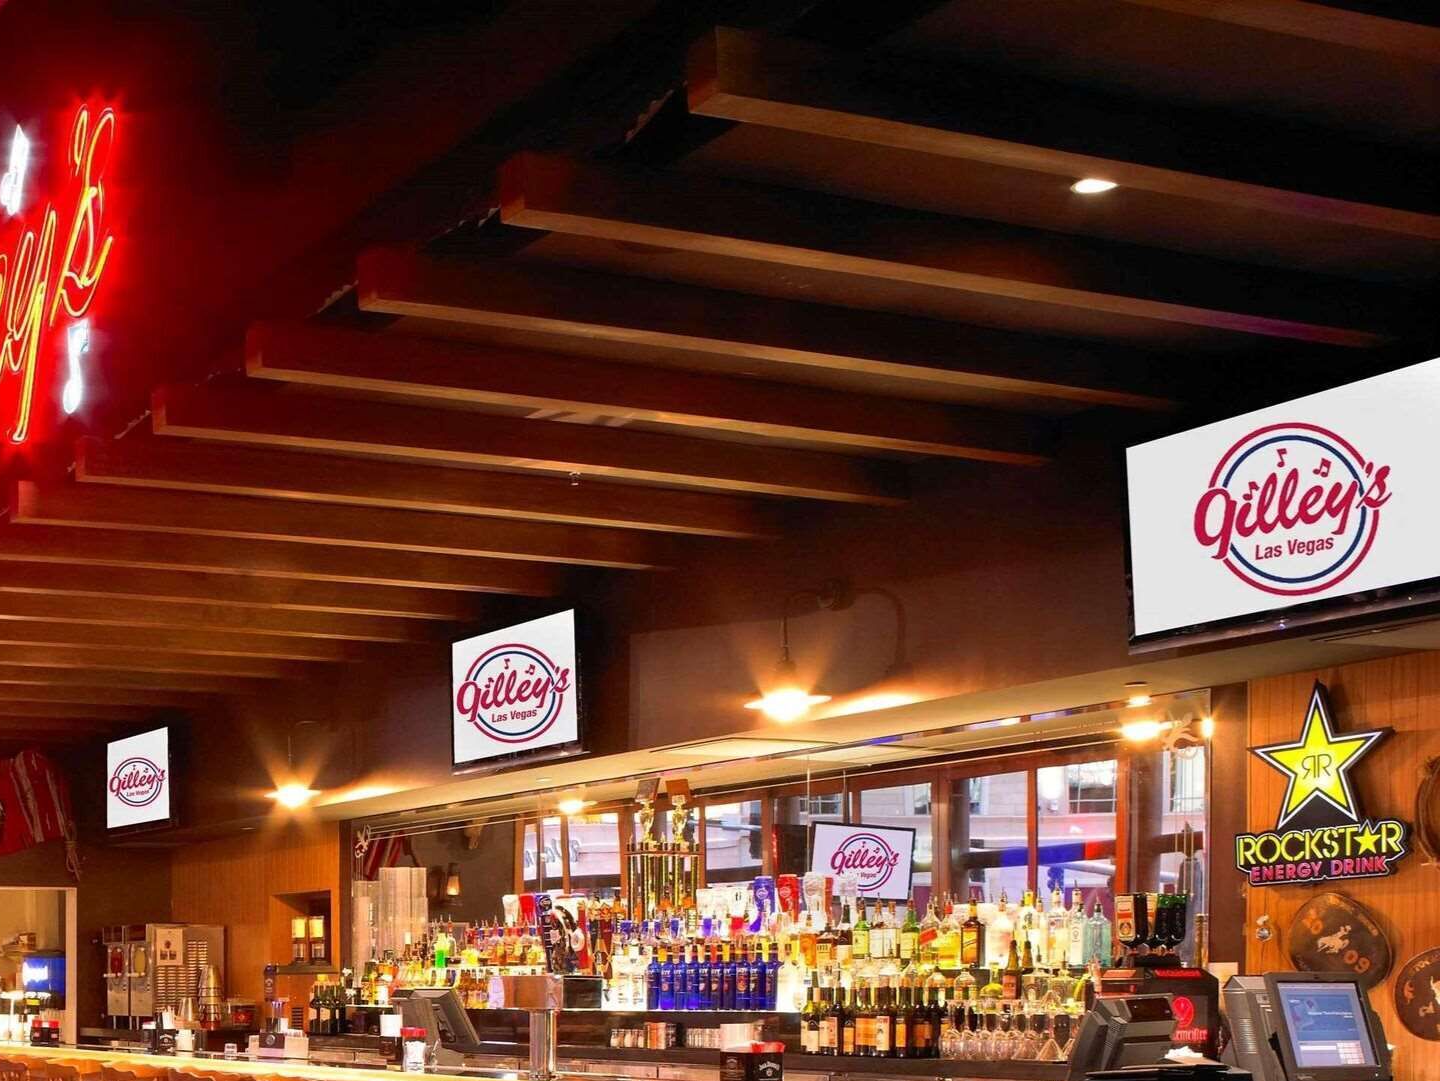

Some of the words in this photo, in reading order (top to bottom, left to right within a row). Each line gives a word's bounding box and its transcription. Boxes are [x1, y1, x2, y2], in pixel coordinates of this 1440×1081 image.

[1193, 461, 1393, 561] Gilley's
[1254, 543, 1283, 561] Las
[1287, 537, 1335, 556] Vegas
[456, 666, 571, 722] Gilley's
[491, 712, 508, 723] Las
[510, 708, 538, 721] Vegas
[109, 768, 166, 797] Gilley's
[830, 847, 900, 875] Gilley's
[1250, 861, 1323, 883] ENERGY
[1329, 855, 1387, 877] DRINK
